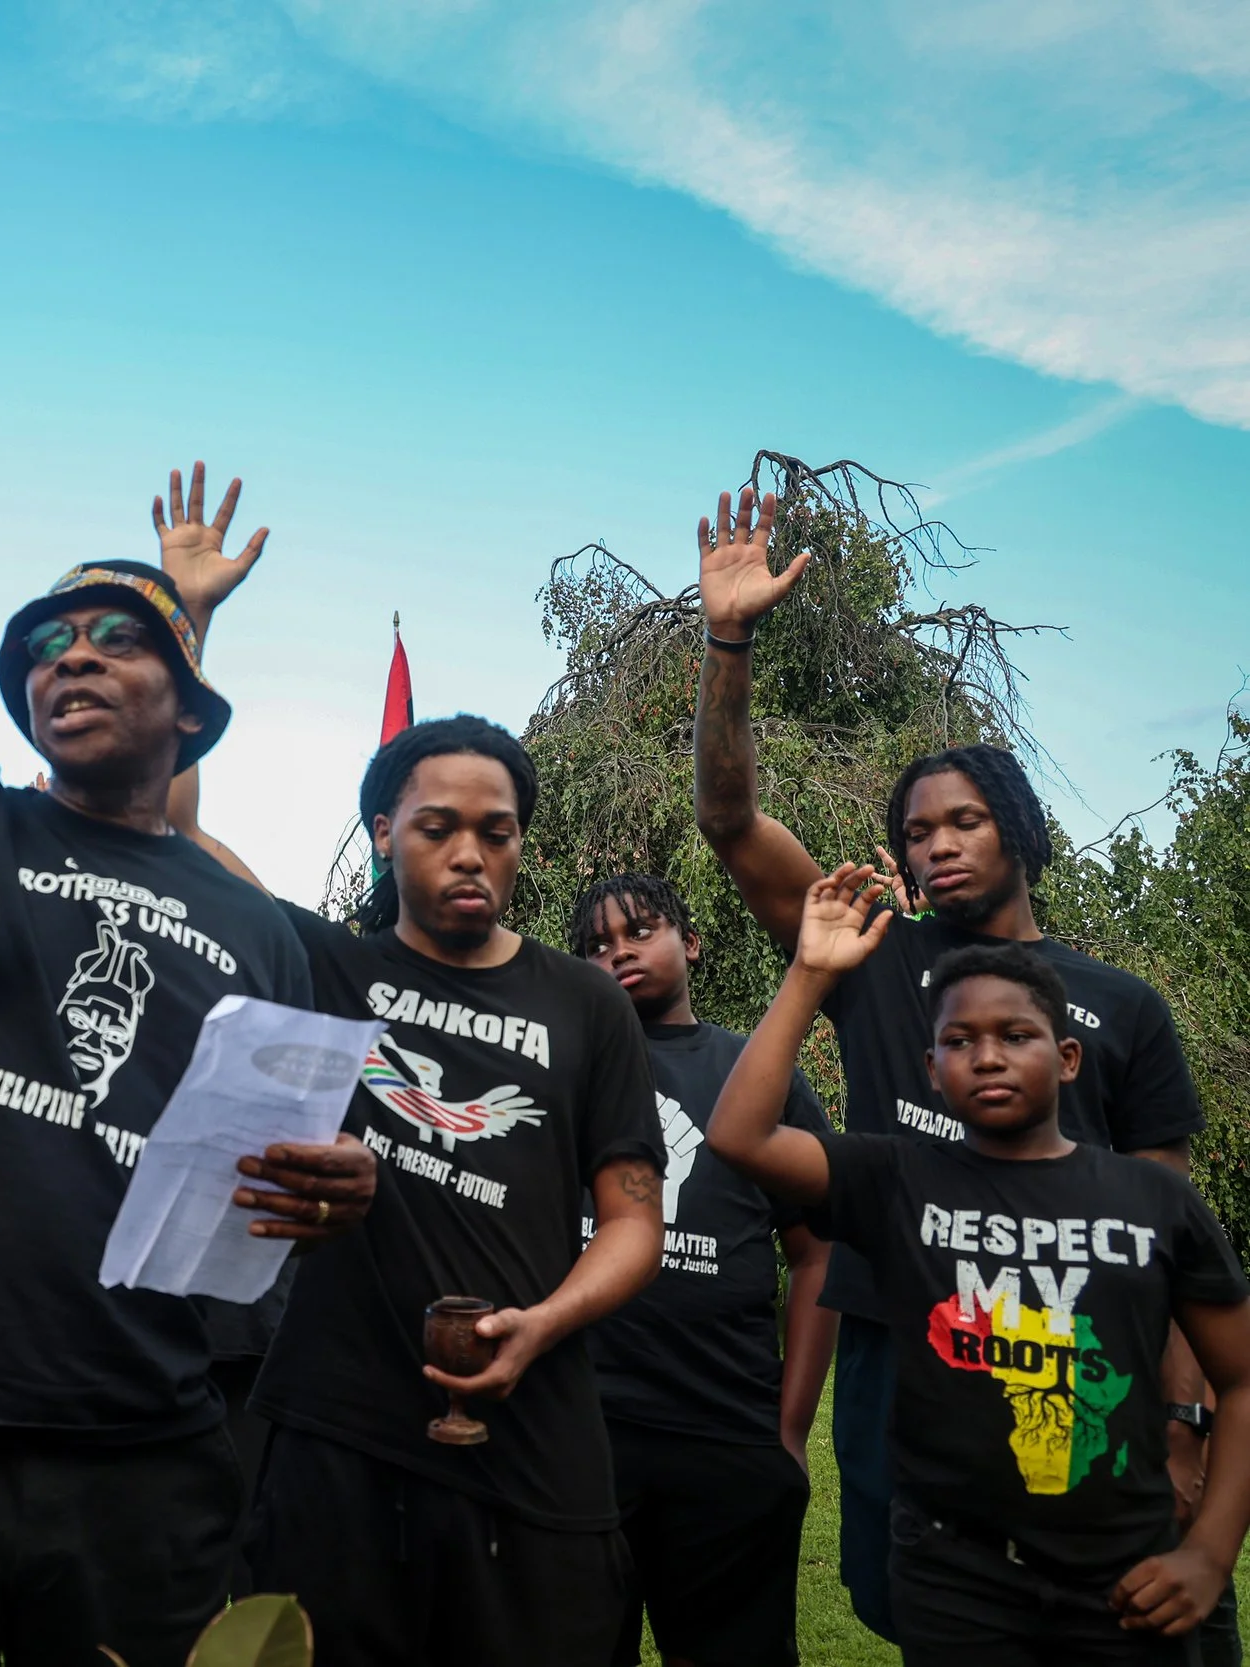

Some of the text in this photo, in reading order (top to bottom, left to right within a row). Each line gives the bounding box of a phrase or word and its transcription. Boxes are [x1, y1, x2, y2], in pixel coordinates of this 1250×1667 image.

[18, 867, 237, 976] ROTHRS UNITED
[366, 981, 550, 1070] SANKOFA
[1066, 1002, 1101, 1029] TED
[897, 1098, 966, 1142] DEVELOPIN
[363, 1125, 393, 1160] PAST
[395, 1144, 453, 1186] PRESENT
[455, 1170, 508, 1209] FUTURE
[661, 1254, 719, 1275] For Justice
[663, 1230, 717, 1258] MATTER
[920, 1203, 1156, 1267] RESPECT
[956, 1259, 1091, 1336] MY
[951, 1328, 1109, 1383] ROOTS
